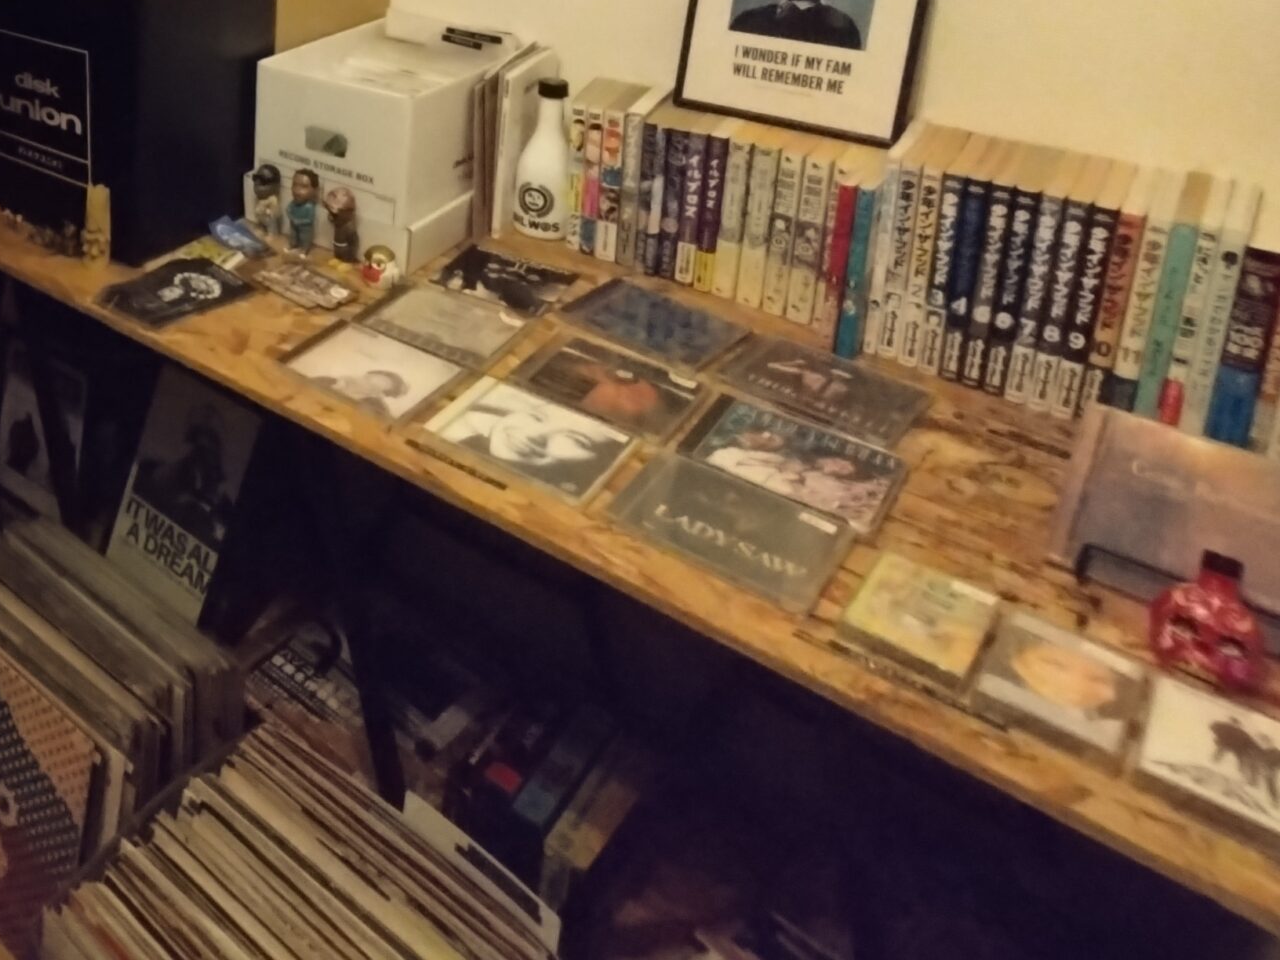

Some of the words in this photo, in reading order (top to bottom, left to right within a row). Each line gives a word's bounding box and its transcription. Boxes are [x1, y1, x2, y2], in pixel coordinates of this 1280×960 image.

[741, 45, 789, 66] WONDER
[790, 53, 802, 68] IF
[804, 55, 825, 71] MY
[825, 59, 852, 77] FAM
[14, 71, 61, 99] disk
[732, 62, 757, 80] WILL
[760, 67, 825, 92] REMEMBER
[825, 78, 845, 95] ME
[278, 149, 312, 167] RECORD
[313, 160, 354, 179] STORAGE
[355, 172, 375, 185] BOX
[951, 296, 968, 315] 4
[1020, 317, 1037, 337] 7
[1043, 324, 1061, 343] 8
[1067, 331, 1086, 350] 9
[126, 522, 140, 545] A
[126, 498, 147, 520] IT
[144, 508, 189, 558] WAS
[186, 543, 214, 576] AL
